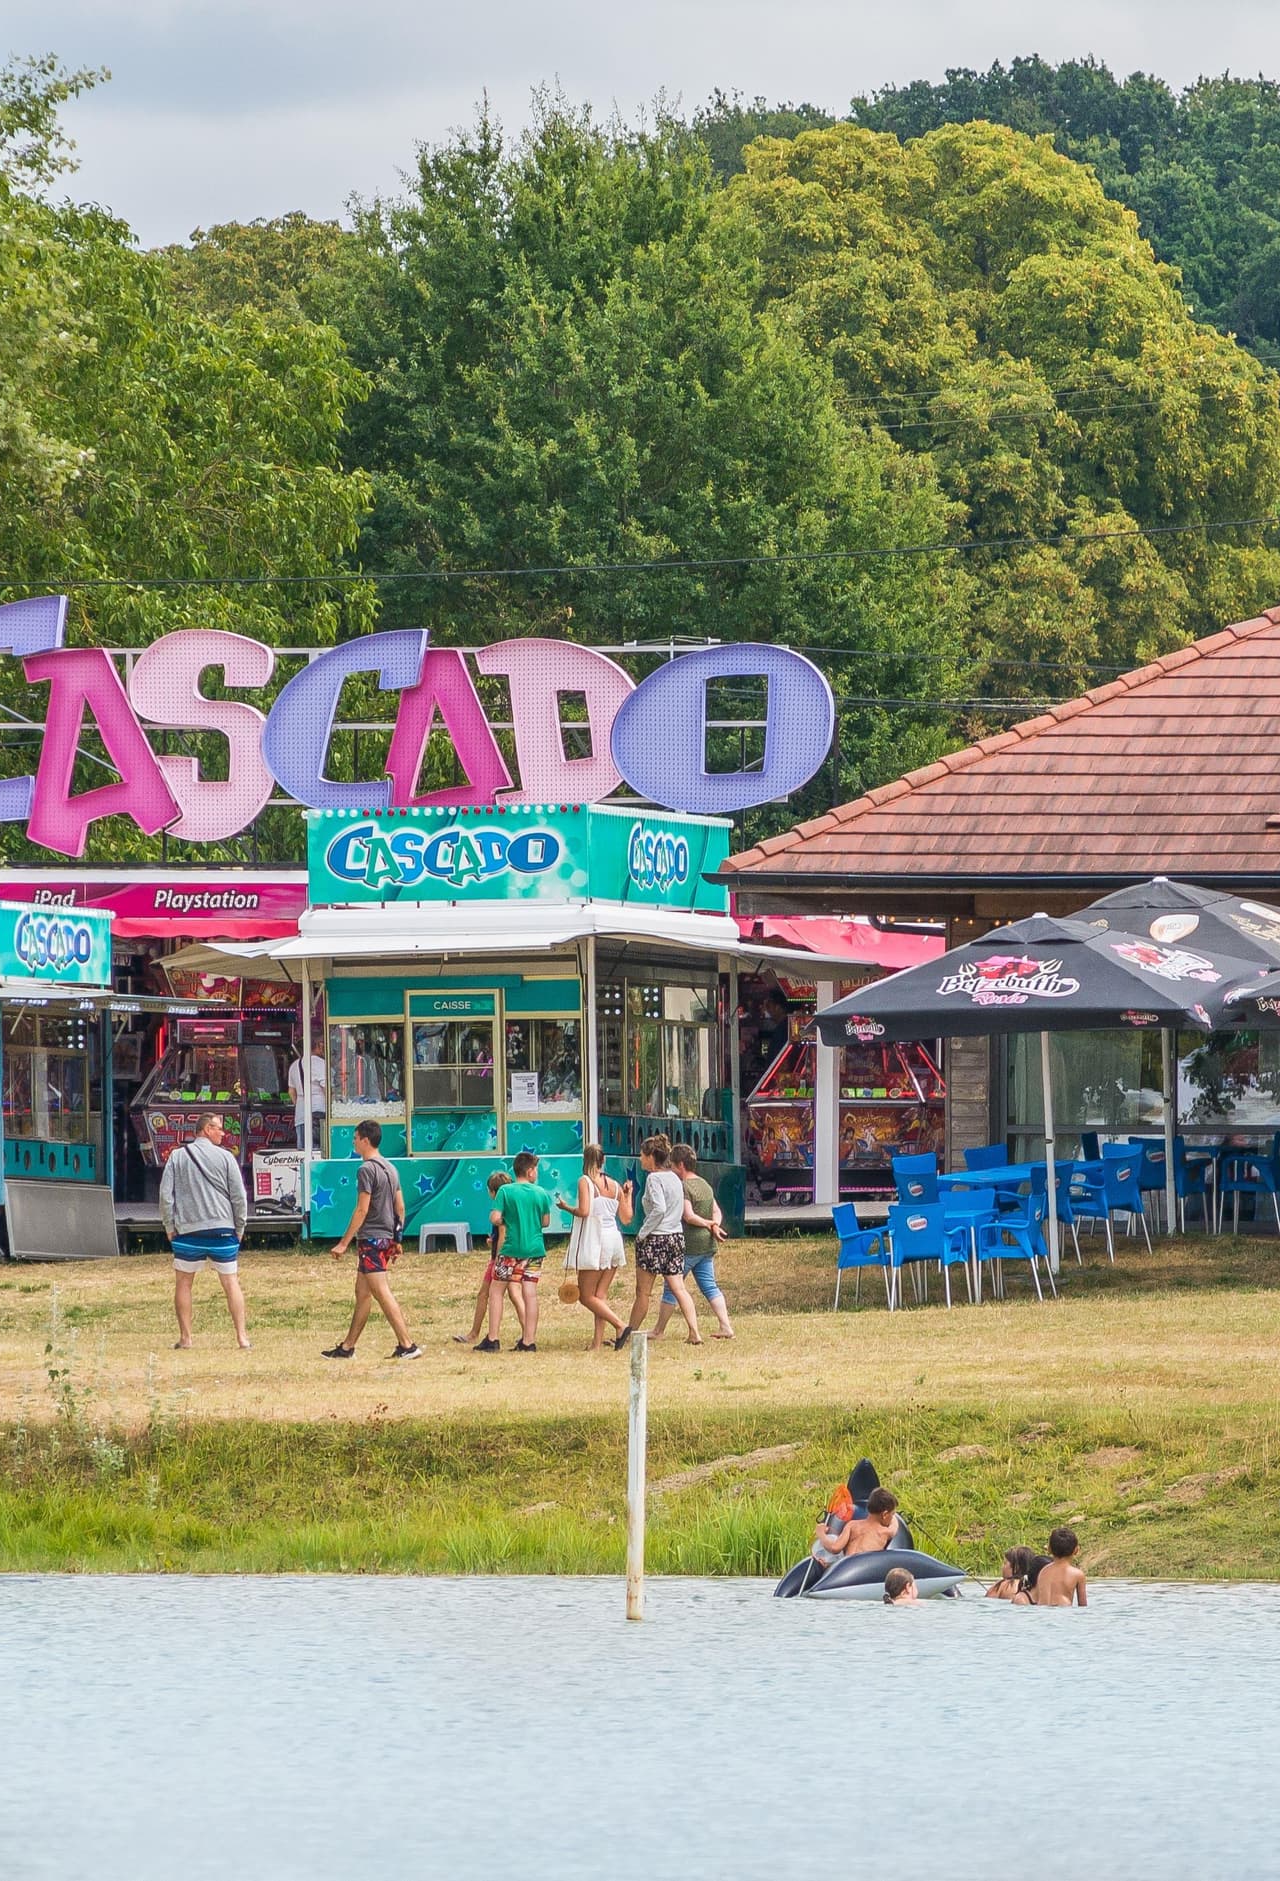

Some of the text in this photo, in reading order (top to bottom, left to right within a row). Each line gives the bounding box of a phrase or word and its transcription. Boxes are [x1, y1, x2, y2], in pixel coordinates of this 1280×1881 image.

[328, 822, 559, 887] CASCADO
[629, 822, 688, 888] CASCADO
[34, 889, 76, 907] iPad
[154, 889, 259, 913] Playstation
[16, 912, 91, 970] CASCADO
[433, 1000, 472, 1011] CAISSE
[263, 1155, 305, 1166] Cyberbike
